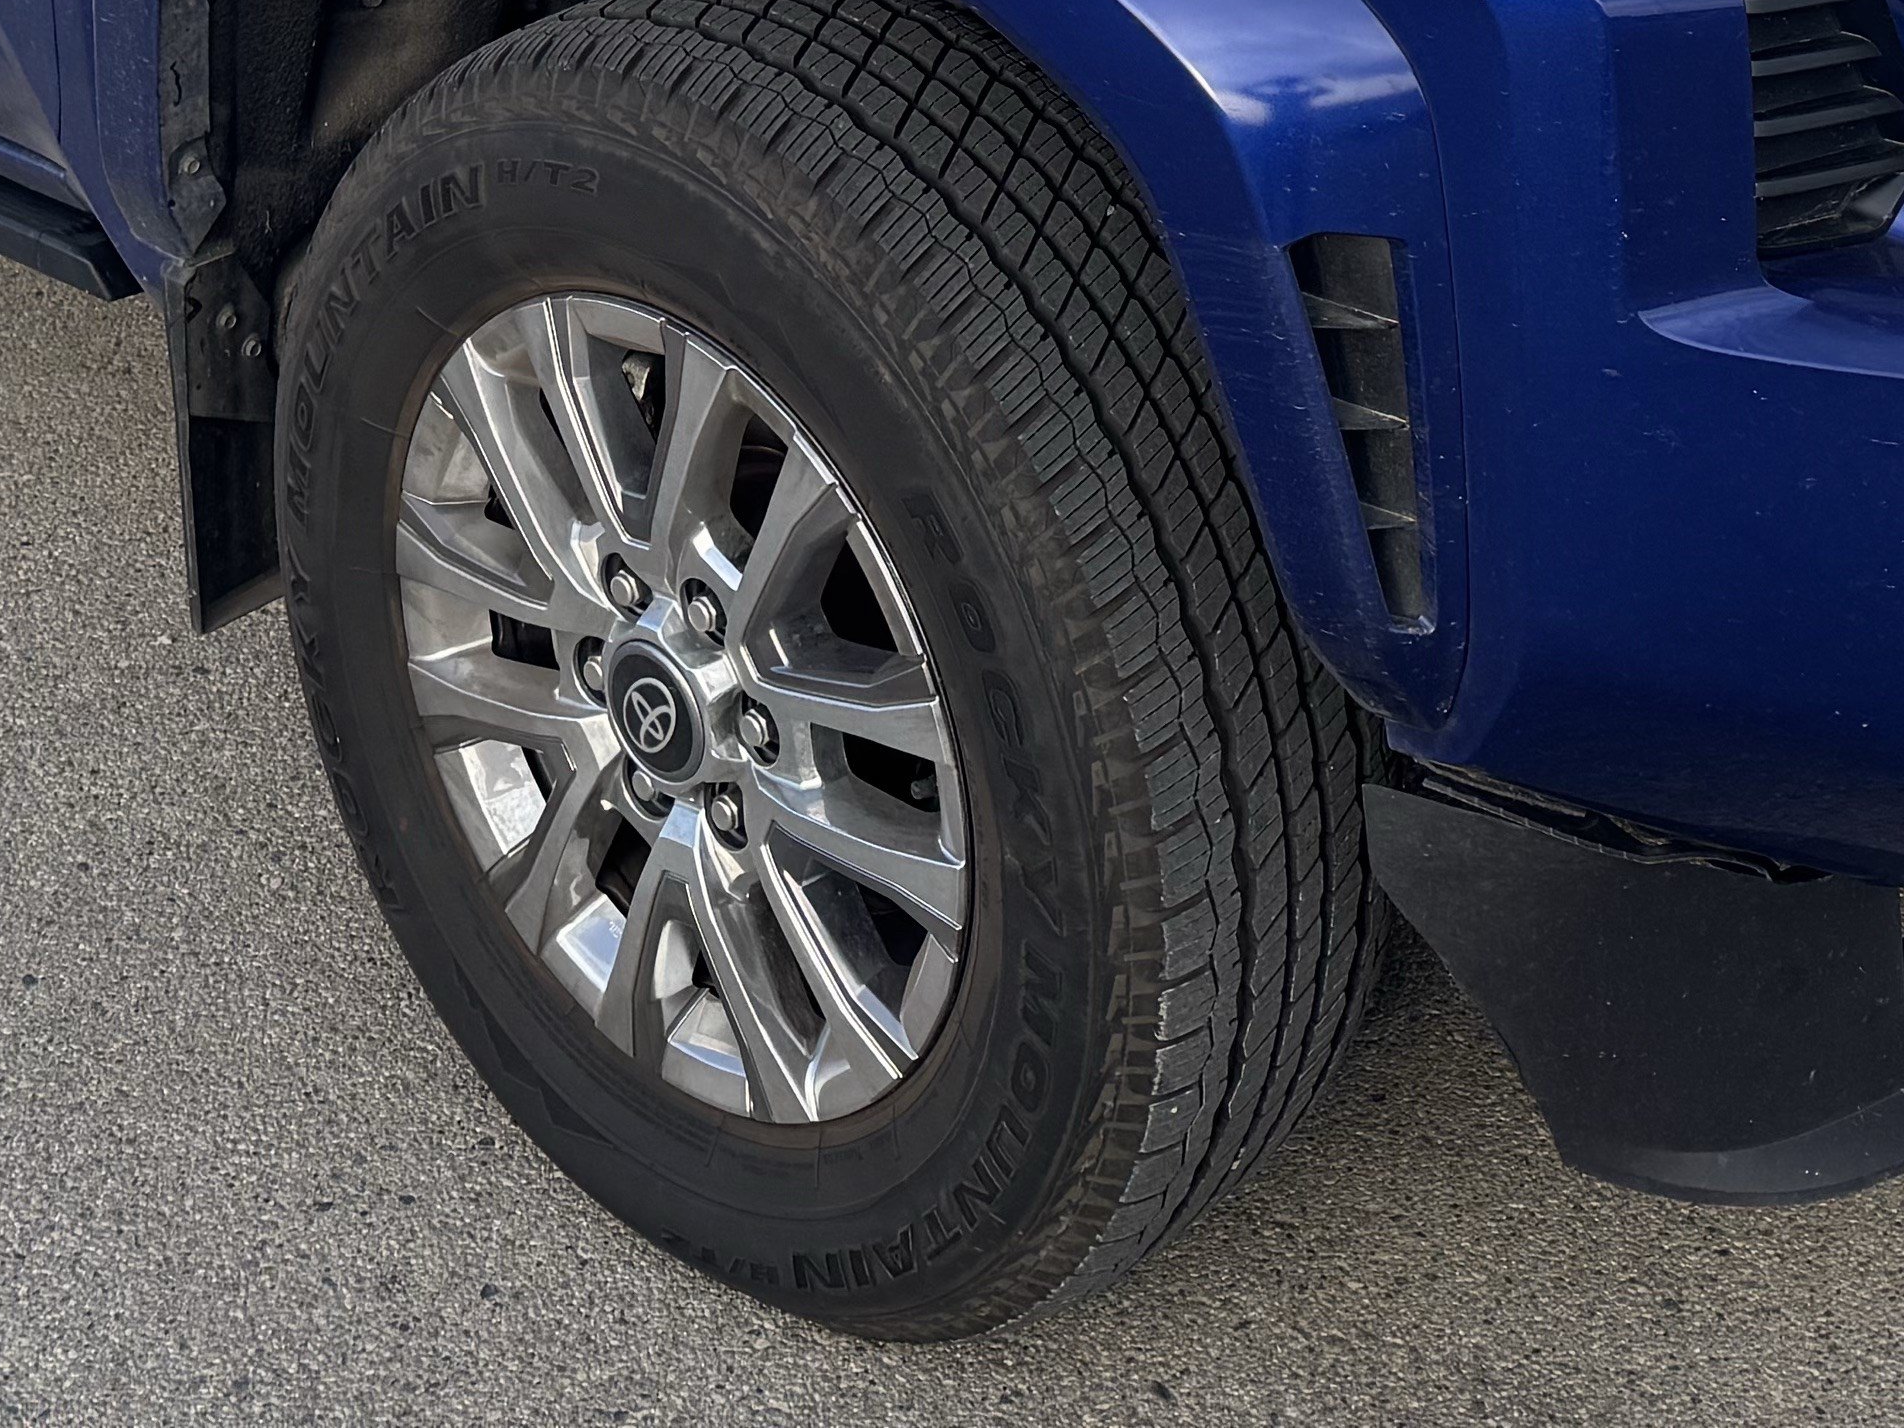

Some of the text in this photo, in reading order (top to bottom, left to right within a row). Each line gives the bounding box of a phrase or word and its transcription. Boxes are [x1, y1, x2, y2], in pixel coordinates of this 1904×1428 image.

[286, 162, 485, 531] MOUNTAIN
[495, 157, 600, 195] H/T2
[899, 487, 1067, 940] ROCKY
[792, 940, 1066, 1292] MOUNTAIN
